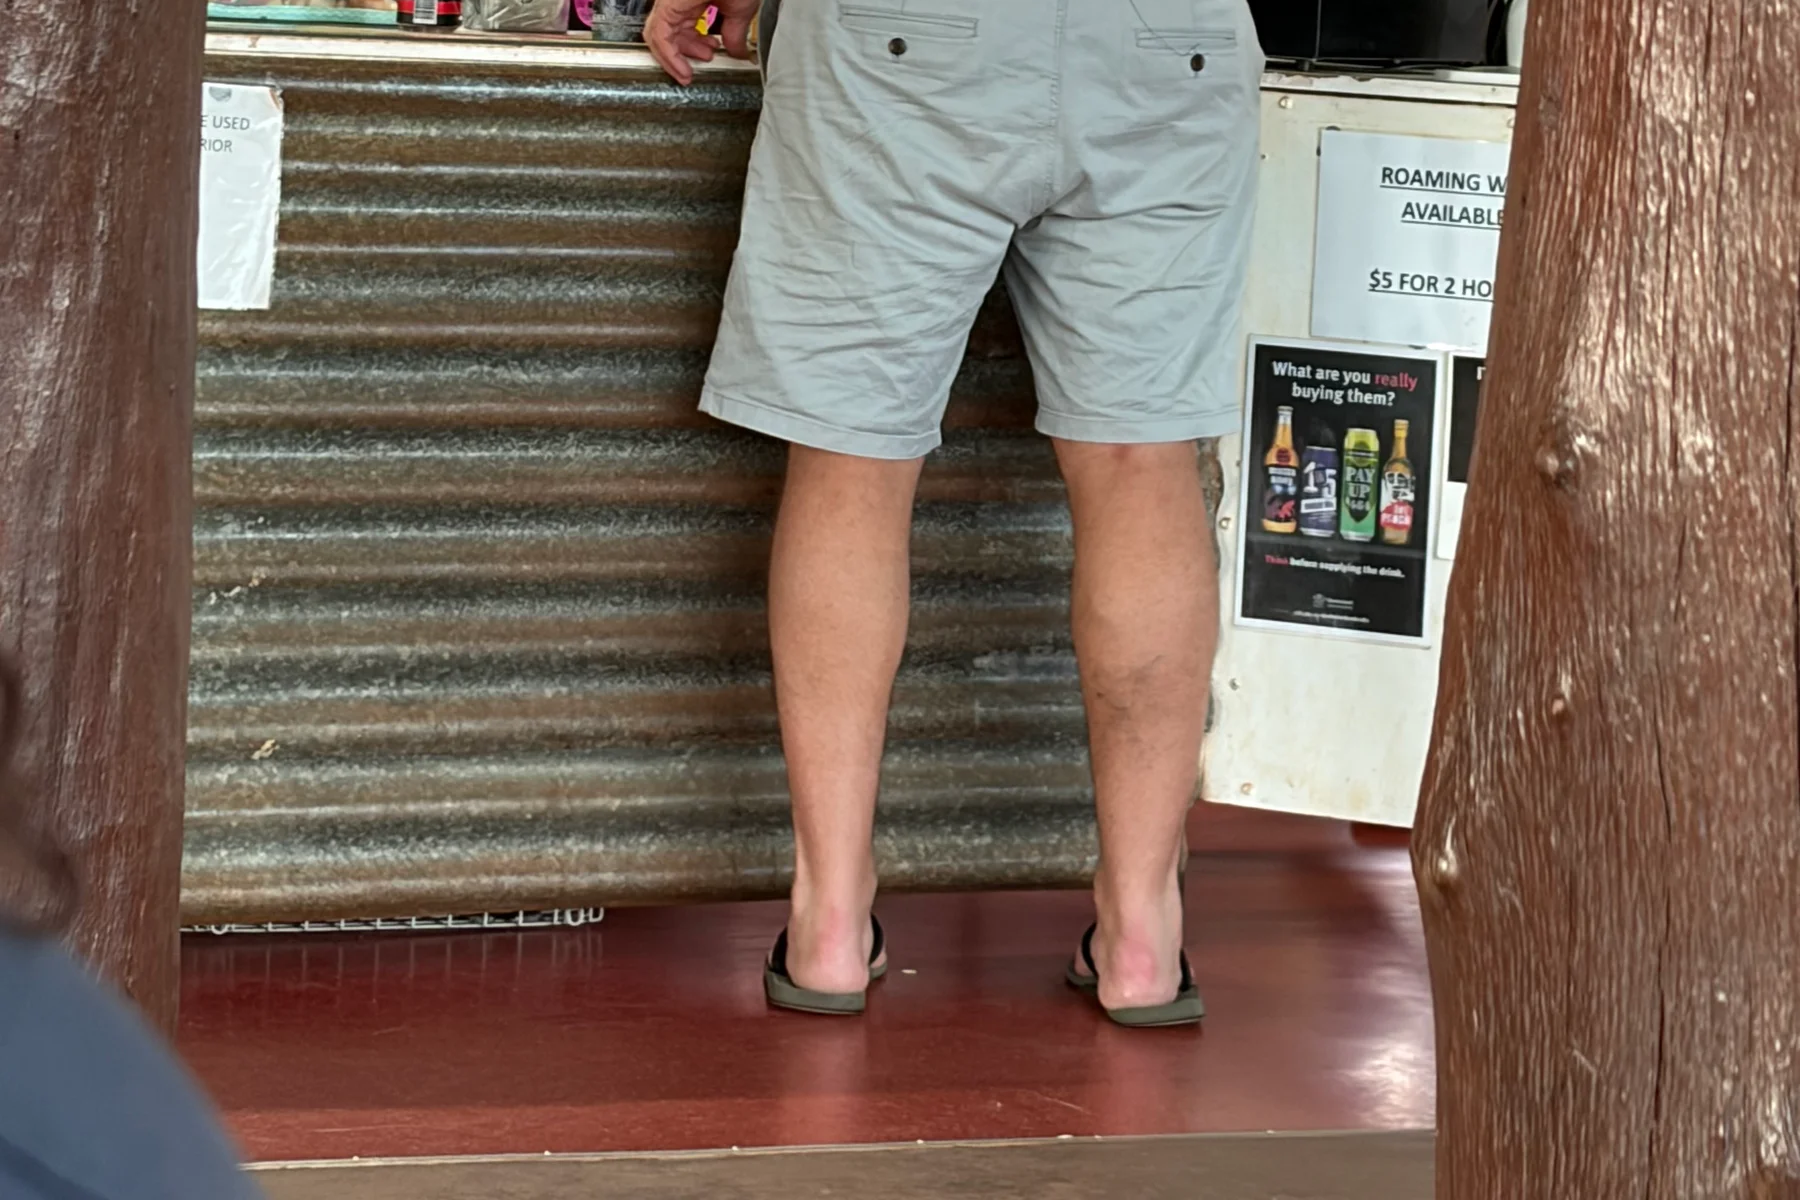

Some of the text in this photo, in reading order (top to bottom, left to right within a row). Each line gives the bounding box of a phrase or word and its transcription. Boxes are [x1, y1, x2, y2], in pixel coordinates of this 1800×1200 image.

[212, 115, 250, 131] USED
[201, 139, 233, 153] RIOR
[1381, 166, 1508, 193] ROAMING W
[1369, 268, 1493, 298] $5 FOR 2 HO
[1272, 360, 1418, 392] What are you really
[1291, 383, 1396, 407] buying them?
[1346, 467, 1375, 483] PAY
[1349, 482, 1371, 499] UP
[1362, 565, 1377, 574] the
